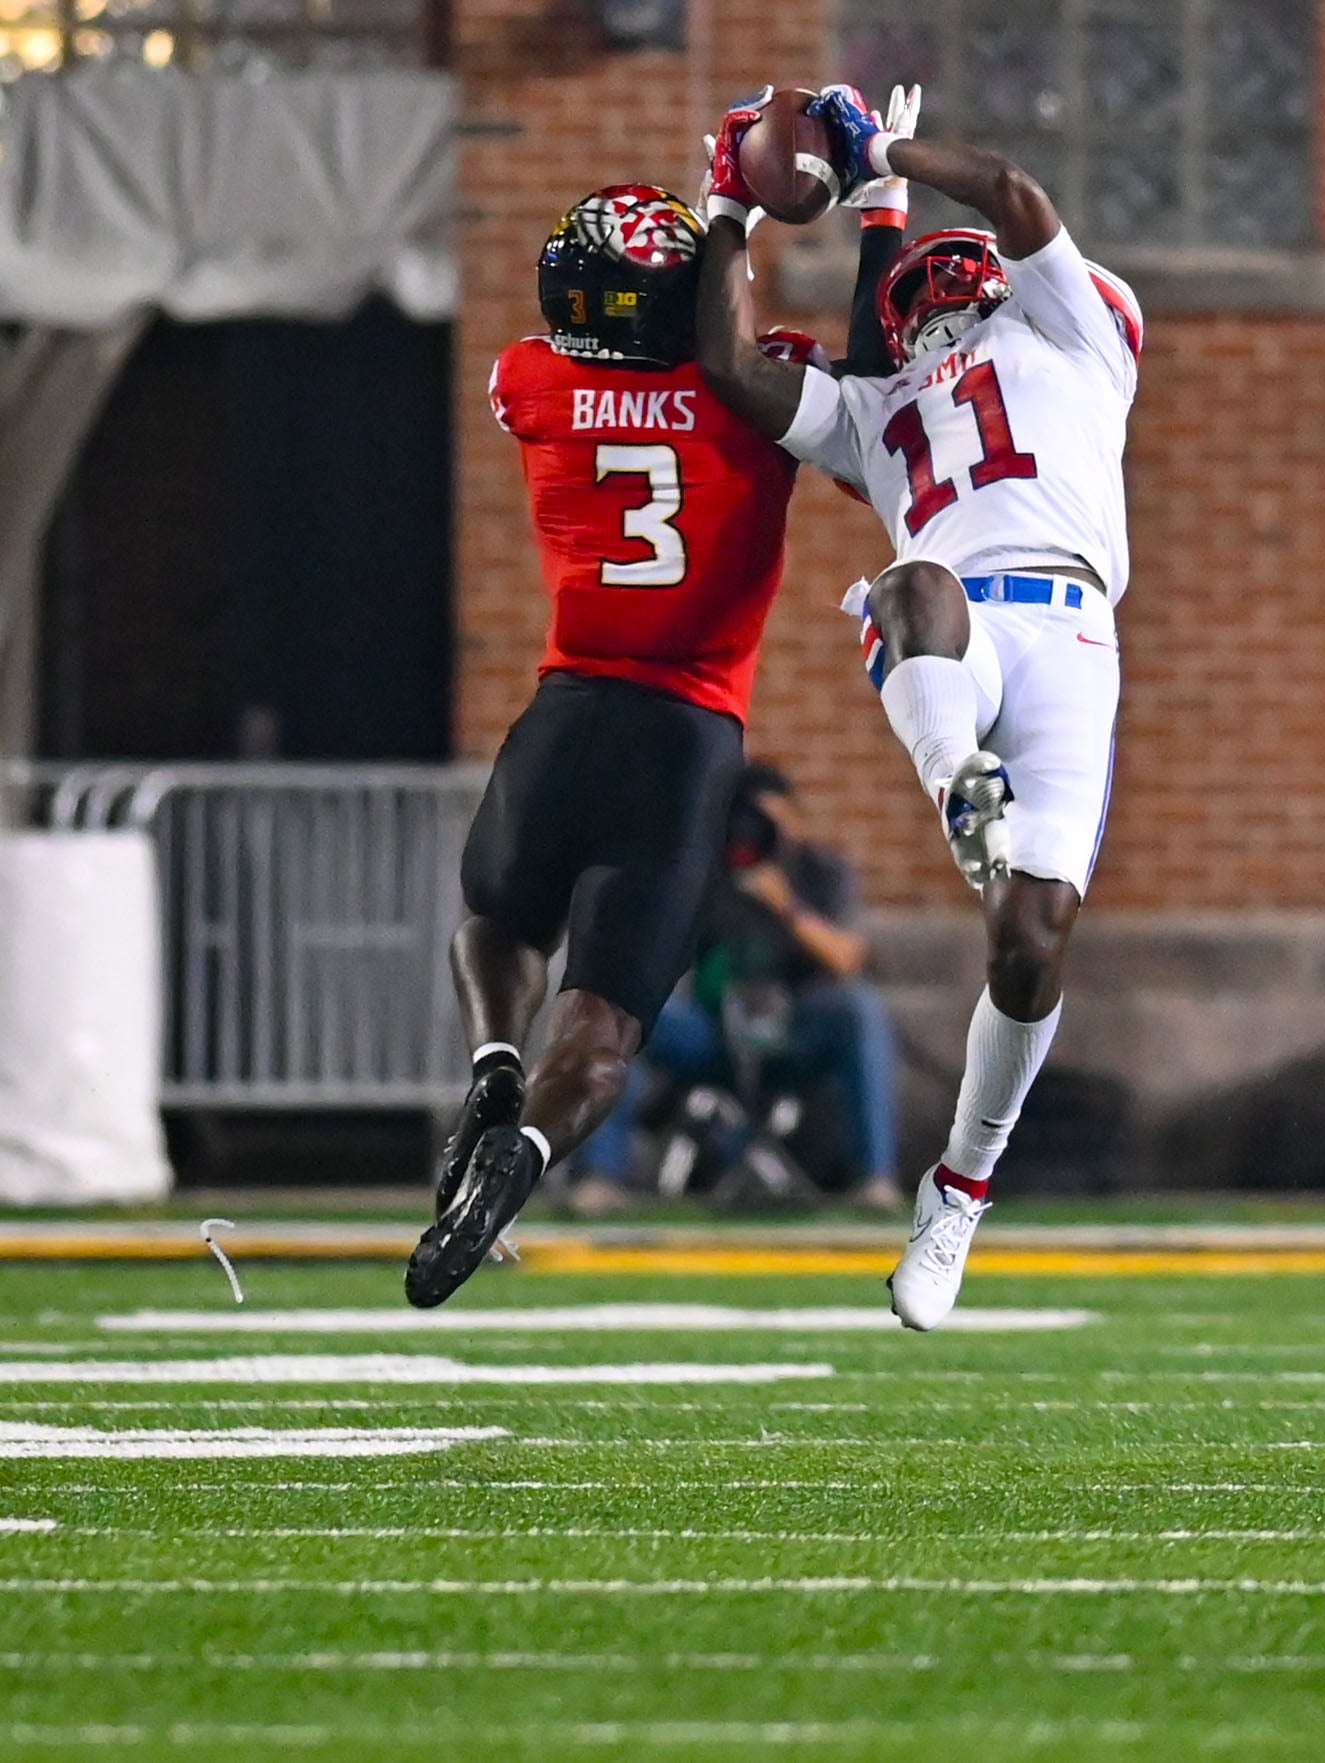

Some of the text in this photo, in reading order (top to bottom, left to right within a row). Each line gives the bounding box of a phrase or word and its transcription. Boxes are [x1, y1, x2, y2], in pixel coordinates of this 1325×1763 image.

[566, 289, 588, 325] 3
[571, 388, 696, 431] BANKS
[882, 358, 1038, 539] 11
[595, 442, 687, 588] 3
